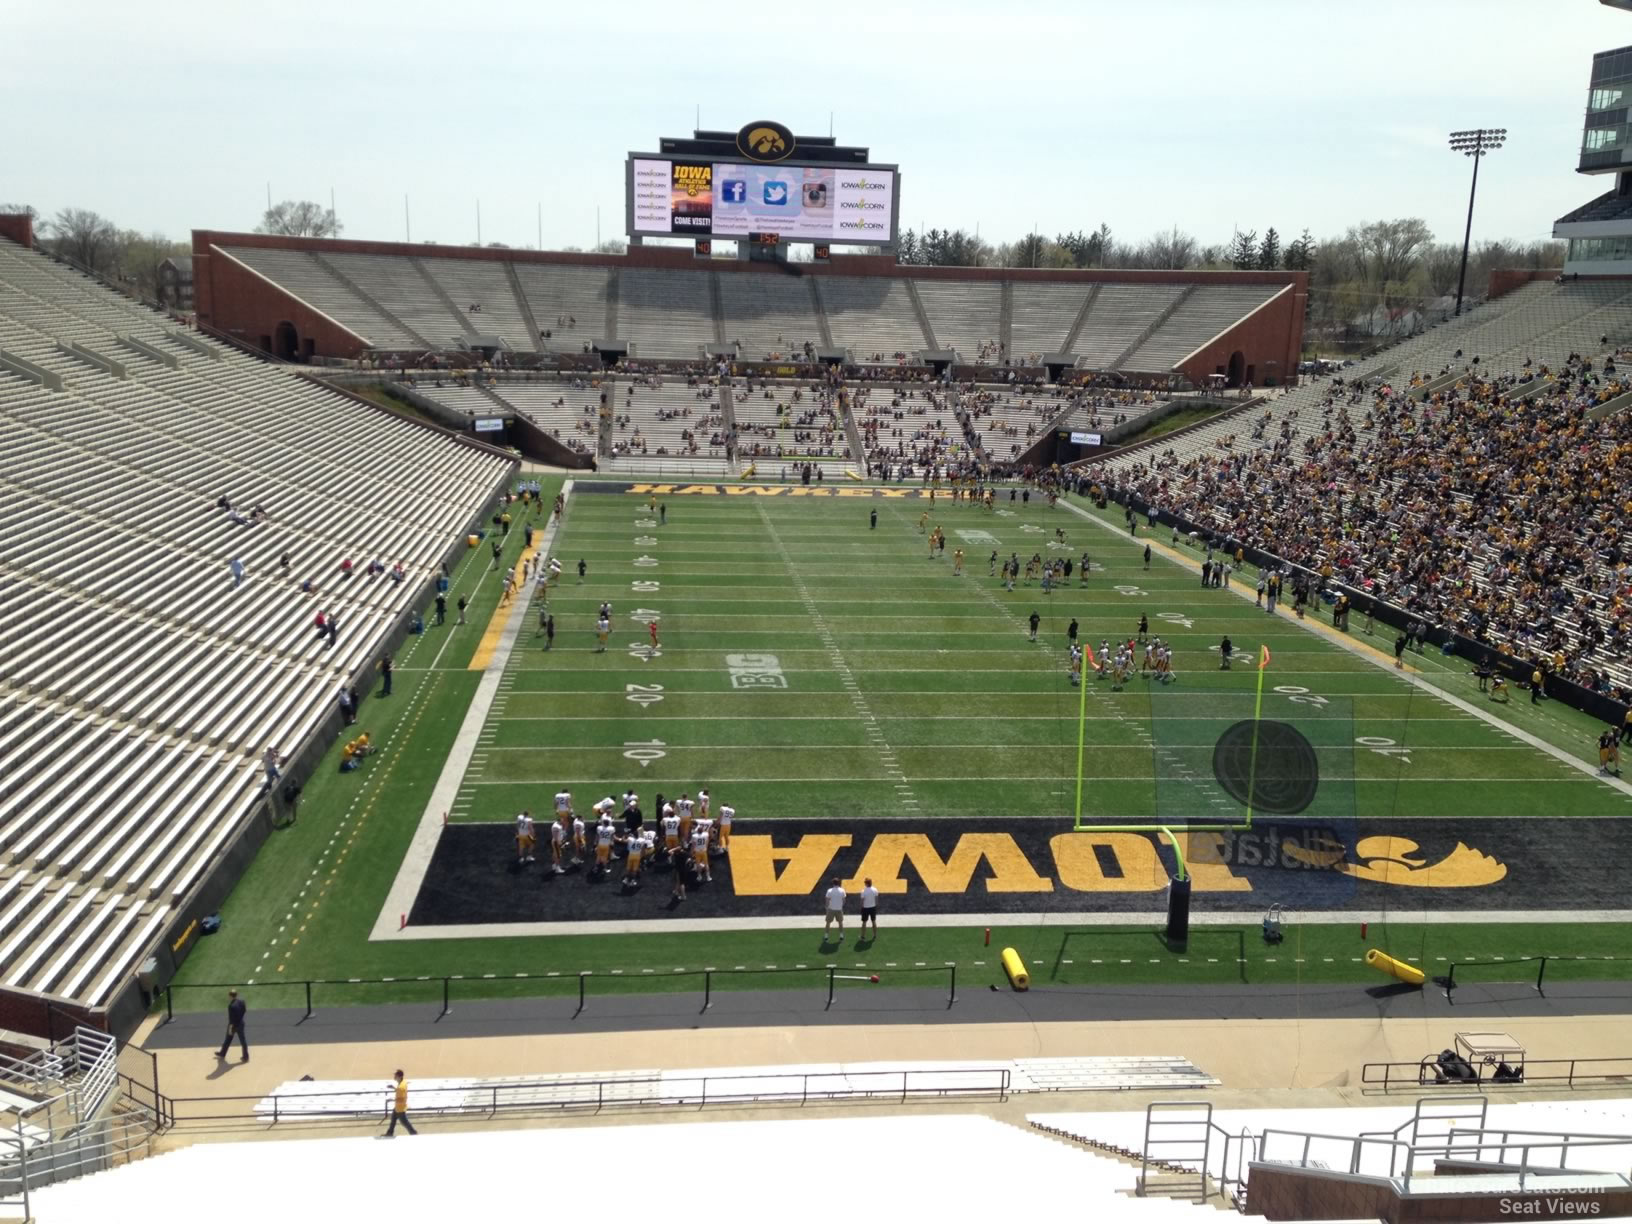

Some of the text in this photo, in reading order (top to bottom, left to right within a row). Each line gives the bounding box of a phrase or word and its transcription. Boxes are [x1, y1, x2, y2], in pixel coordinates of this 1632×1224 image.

[674, 166, 712, 179] IOWA
[674, 216, 692, 225] COME
[692, 218, 711, 226] VISIT!
[698, 243, 710, 253] 40
[816, 248, 828, 258] 40
[626, 684, 664, 702] 20
[1273, 686, 1330, 704] 20
[622, 738, 666, 759] 10
[1355, 736, 1412, 756] 10
[729, 833, 1253, 896] IOWA
